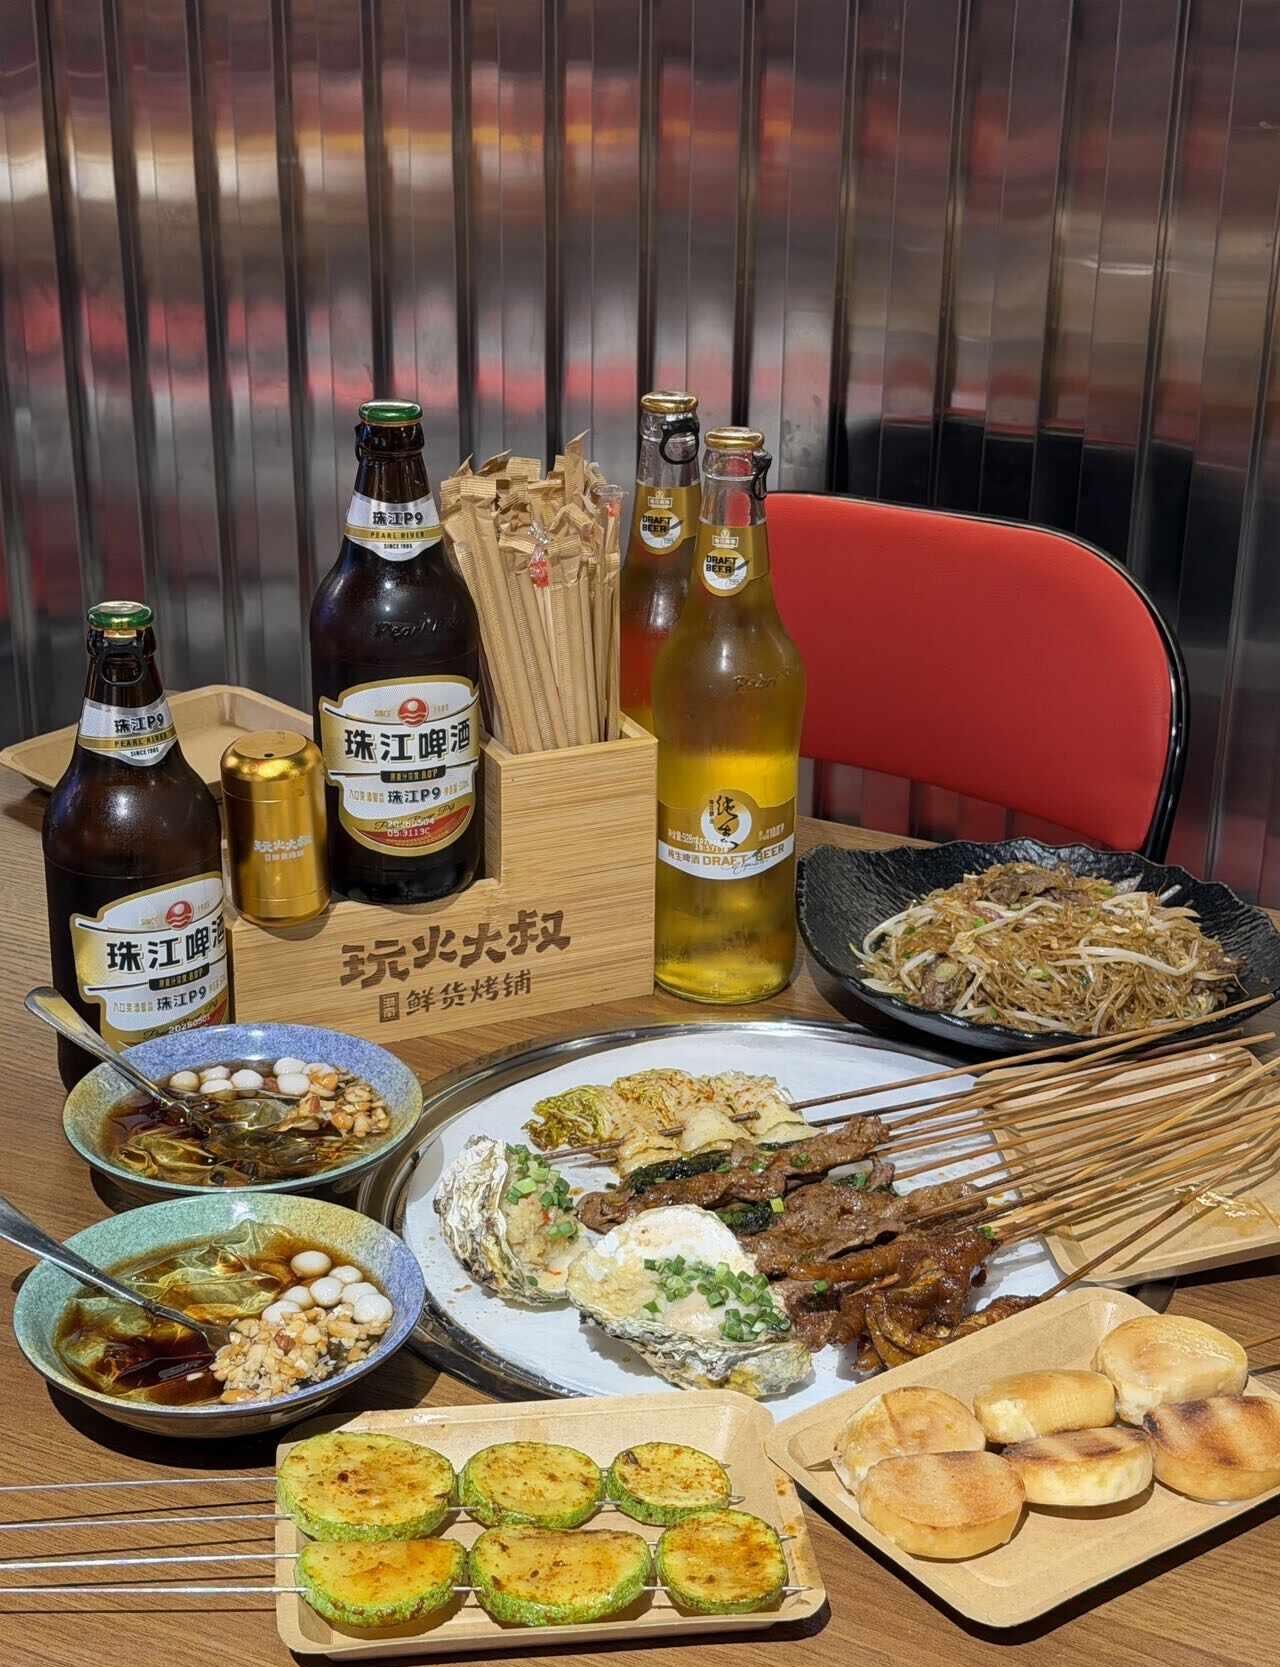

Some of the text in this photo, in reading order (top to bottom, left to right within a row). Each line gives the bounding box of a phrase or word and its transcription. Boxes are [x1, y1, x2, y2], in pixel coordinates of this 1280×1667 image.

[641, 515, 673, 525] DRAFT
[641, 524, 668, 533] BEER
[370, 531, 399, 539] PEARL
[705, 555, 738, 566] DRAFT
[705, 563, 734, 574] BEER
[114, 738, 143, 748] PEARL
[344, 718, 471, 762] 珠江啤酒
[387, 786, 442, 804] 珠江P9
[702, 854, 748, 866] DRAFT
[755, 843, 785, 862] BEER
[106, 912, 225, 972] 珠江啤酒
[339, 909, 571, 990] 玩火大叔
[156, 985, 207, 1011] 珠江P9
[405, 969, 532, 1016] 鲜货烤铺
